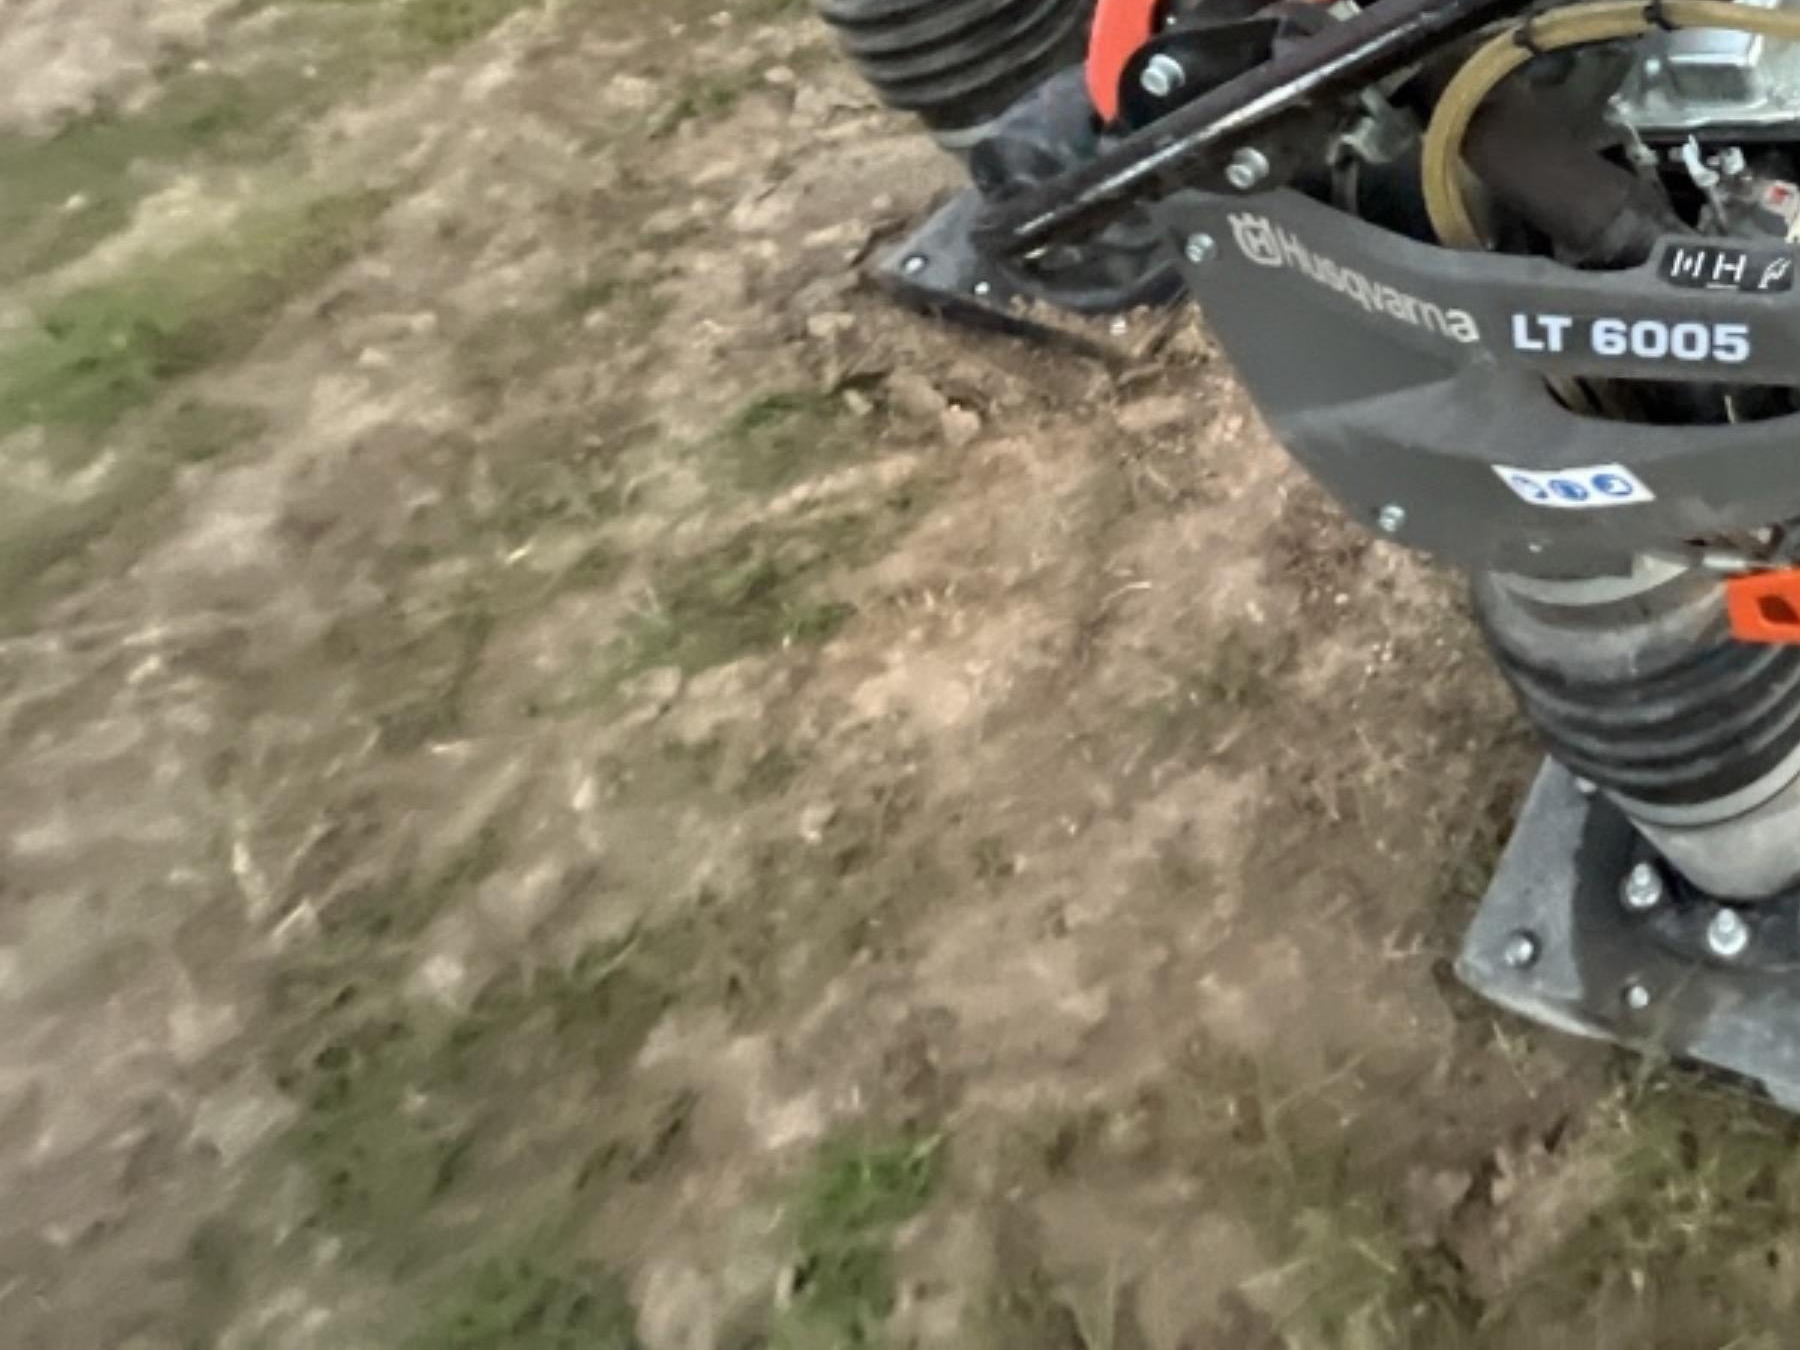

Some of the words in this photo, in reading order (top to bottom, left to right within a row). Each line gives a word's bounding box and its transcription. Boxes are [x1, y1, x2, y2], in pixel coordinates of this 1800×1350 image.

[1276, 227, 1481, 343] Husqvarna
[1511, 313, 1573, 352] LT
[1590, 317, 1750, 363] 6005
